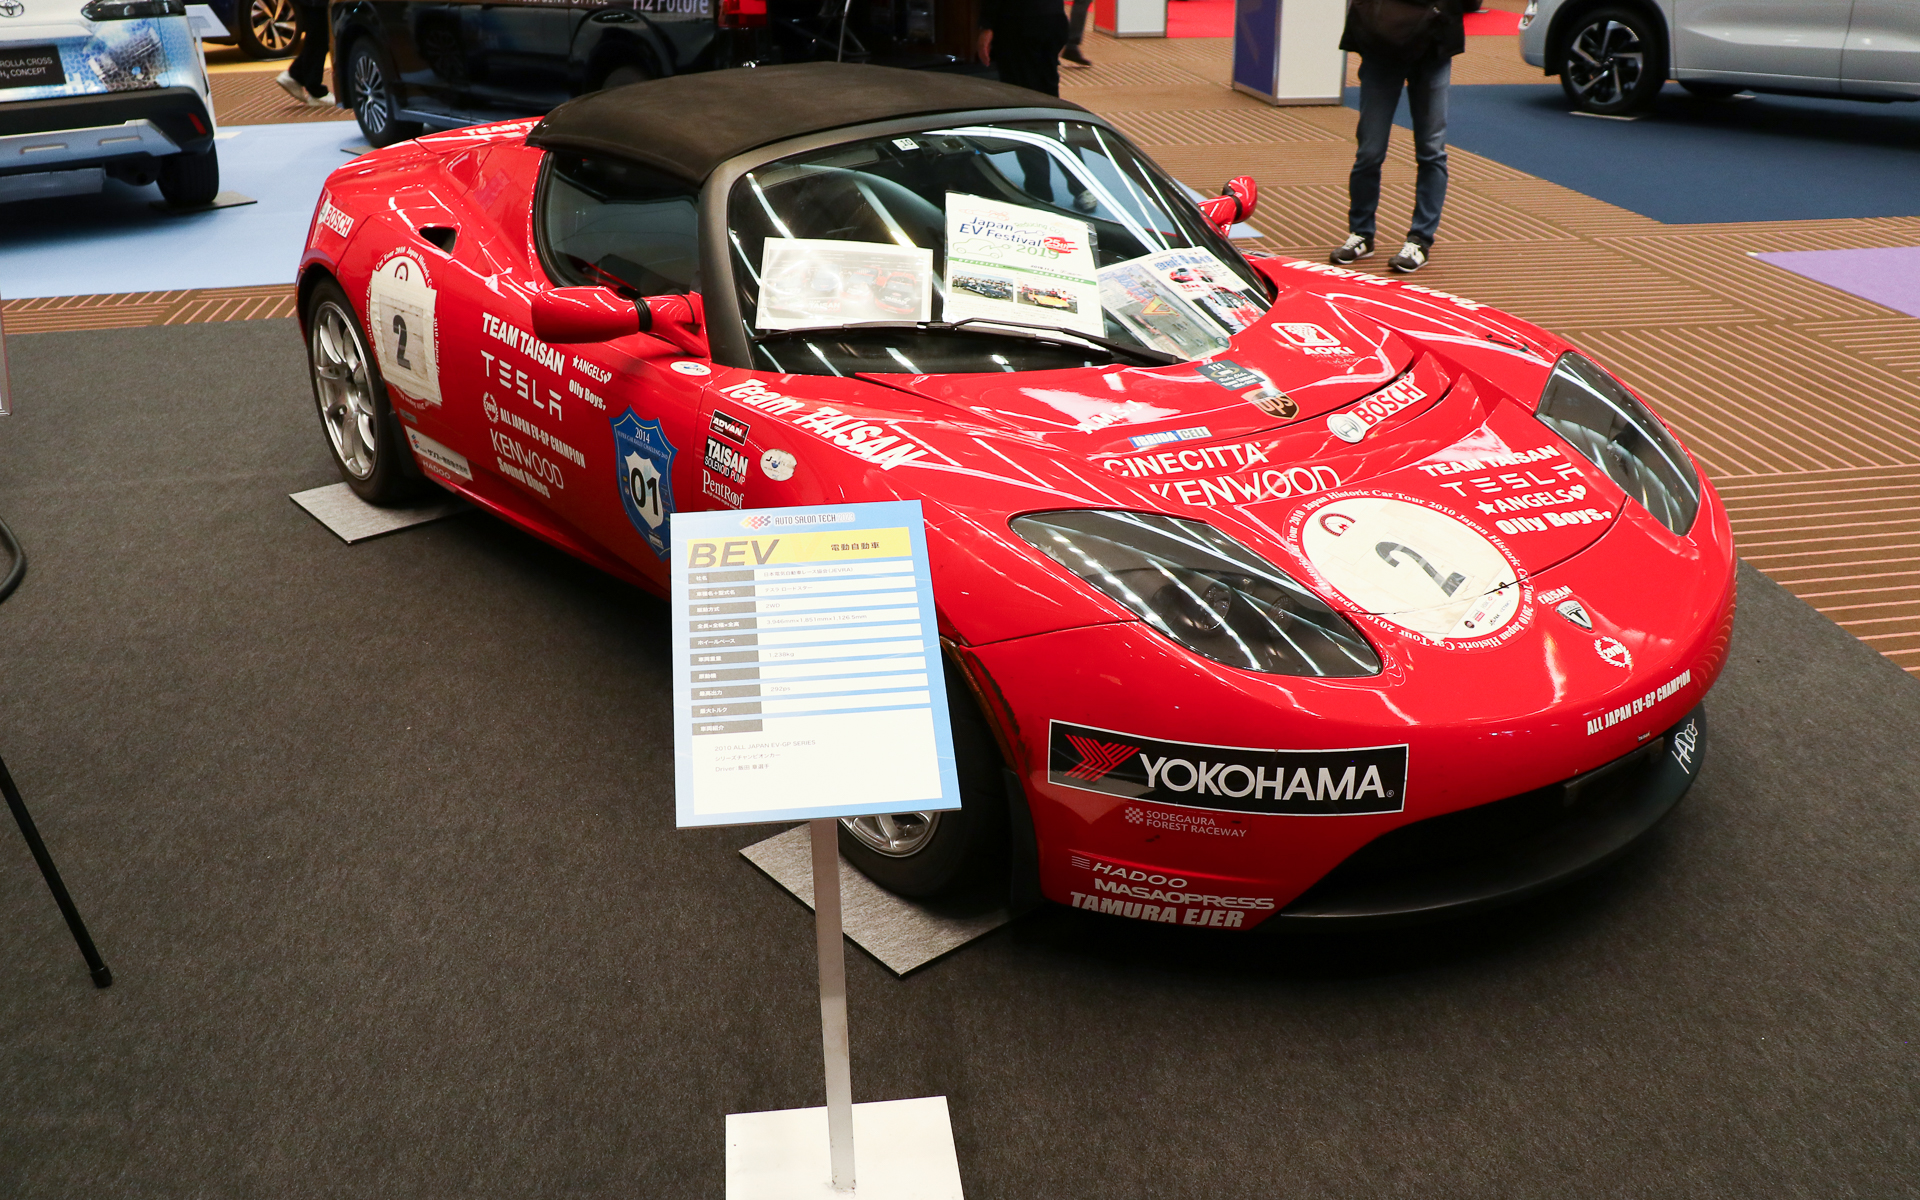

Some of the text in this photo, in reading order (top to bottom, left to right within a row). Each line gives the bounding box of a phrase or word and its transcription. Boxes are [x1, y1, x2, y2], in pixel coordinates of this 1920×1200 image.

[26, 57, 53, 65] CROSS
[10, 67, 47, 77] CONCEPT
[325, 207, 353, 236] BOSCH
[970, 217, 1014, 232] Japan
[959, 223, 983, 235] EV
[986, 229, 1042, 247] Festival
[1016, 244, 1060, 260] 2019
[393, 314, 411, 371] 2
[482, 312, 565, 376] TEAM TAISAN
[1302, 346, 1355, 356] AOKI
[578, 357, 605, 383] ANGELS
[1207, 362, 1226, 371] 111
[480, 350, 562, 421] TESLA
[568, 379, 584, 399] Oily
[1257, 394, 1293, 415] ups
[1352, 381, 1423, 426] BOSCH
[713, 417, 743, 437] ADVAN
[719, 378, 805, 416] Team
[792, 406, 929, 471] TAISAN
[1180, 426, 1209, 439] CELL
[500, 407, 586, 469] ALL JAPAN EV-GP CHAMPION
[635, 427, 650, 444] 2014
[490, 428, 564, 490] KENWOOD
[707, 438, 749, 477] TAISAN
[1418, 444, 1561, 477] TEAM TAISAN
[422, 460, 451, 480] HADOO
[1440, 462, 1585, 497] TESLA
[631, 467, 659, 516] 01
[702, 468, 745, 510] PentRoof
[1149, 465, 1342, 507] KENWOOD
[1326, 489, 1370, 501] Historic
[1371, 490, 1394, 498] Car
[1302, 495, 1330, 511] Japan
[1395, 492, 1426, 505] Tour
[1428, 501, 1456, 516] 2010
[1493, 488, 1574, 513] ANGELS
[775, 516, 793, 525] AUTO
[794, 514, 817, 524] SALON
[818, 514, 836, 522] TECH
[1289, 509, 1306, 526] 2010
[1456, 514, 1489, 535] Japan
[1495, 514, 1548, 535] Oily
[688, 538, 780, 569] BEV
[830, 541, 880, 551] 電動自動車
[1488, 533, 1520, 567] Historic
[1375, 541, 1466, 597] 2
[1537, 585, 1574, 605] TAISAN
[1366, 613, 1396, 633] 2010
[1520, 604, 1534, 625] 2010
[697, 637, 736, 645] ホイールベース
[1399, 629, 1431, 647] Tour
[1498, 622, 1525, 640] Japan
[1458, 636, 1502, 652] Historic
[1587, 668, 1692, 736] ALL JAPAN EV-GP CHAMPION
[1139, 752, 1386, 801] YOKOHAMA
[1146, 810, 1216, 827] SODEGAURA
[1146, 819, 1247, 838] FOREST RACEWAY
[1092, 862, 1188, 888] HADOO
[1094, 878, 1275, 910] MASAOPRESS
[1070, 891, 1246, 928] TAMURA EJER
